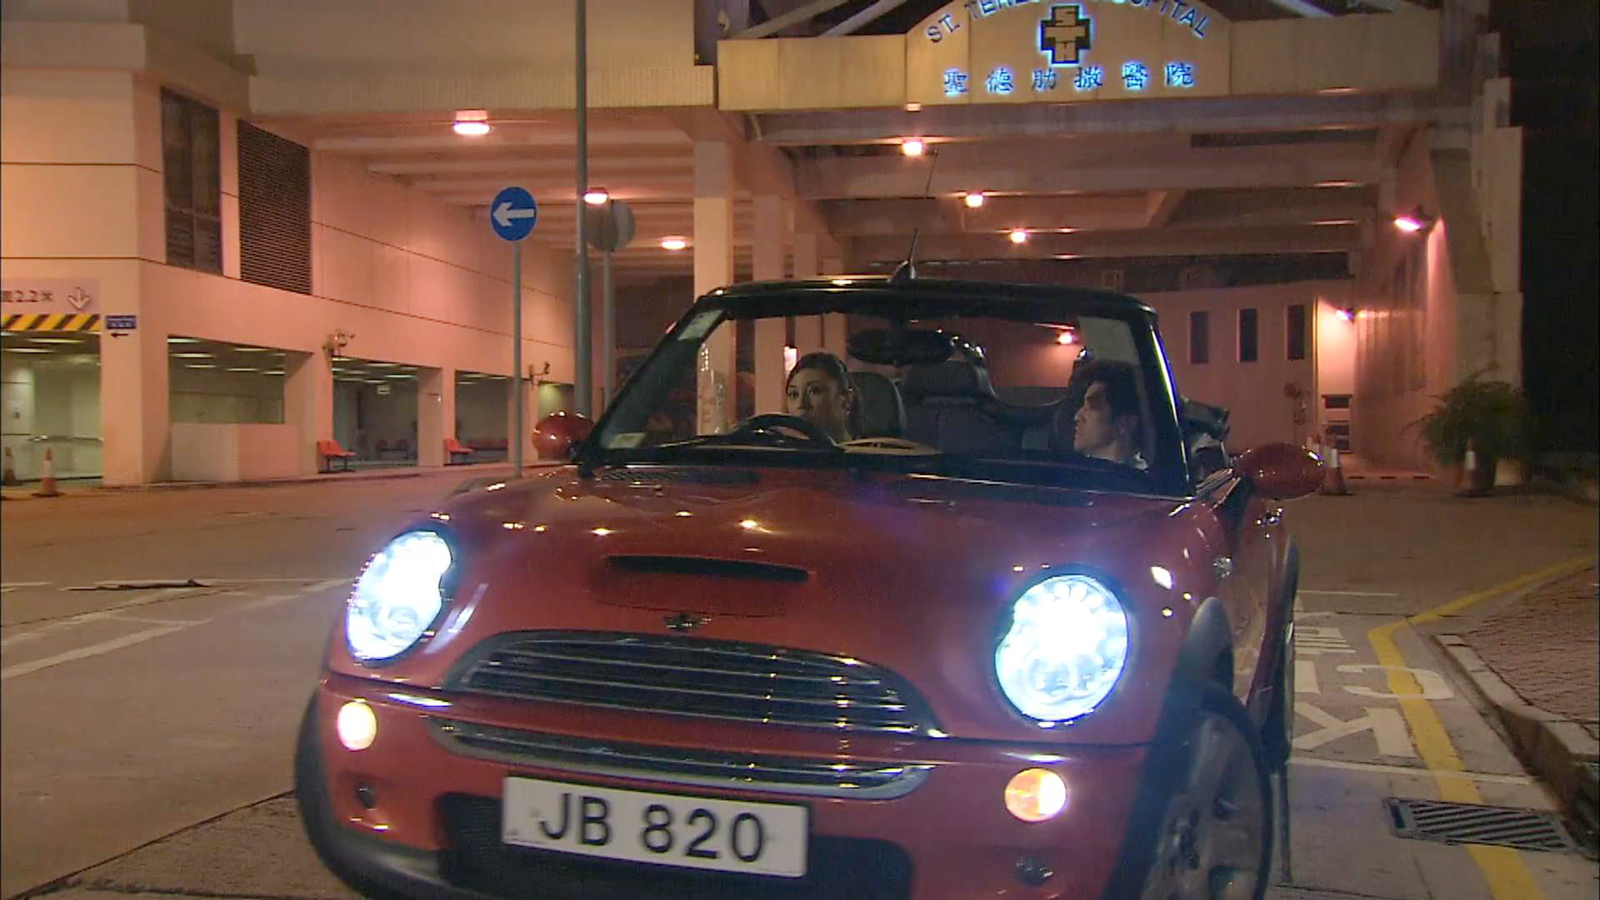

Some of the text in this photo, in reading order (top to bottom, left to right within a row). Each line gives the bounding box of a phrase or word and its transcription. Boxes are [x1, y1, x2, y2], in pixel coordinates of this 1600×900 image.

[927, 14, 961, 43] ST.
[539, 792, 765, 863] JB 820
